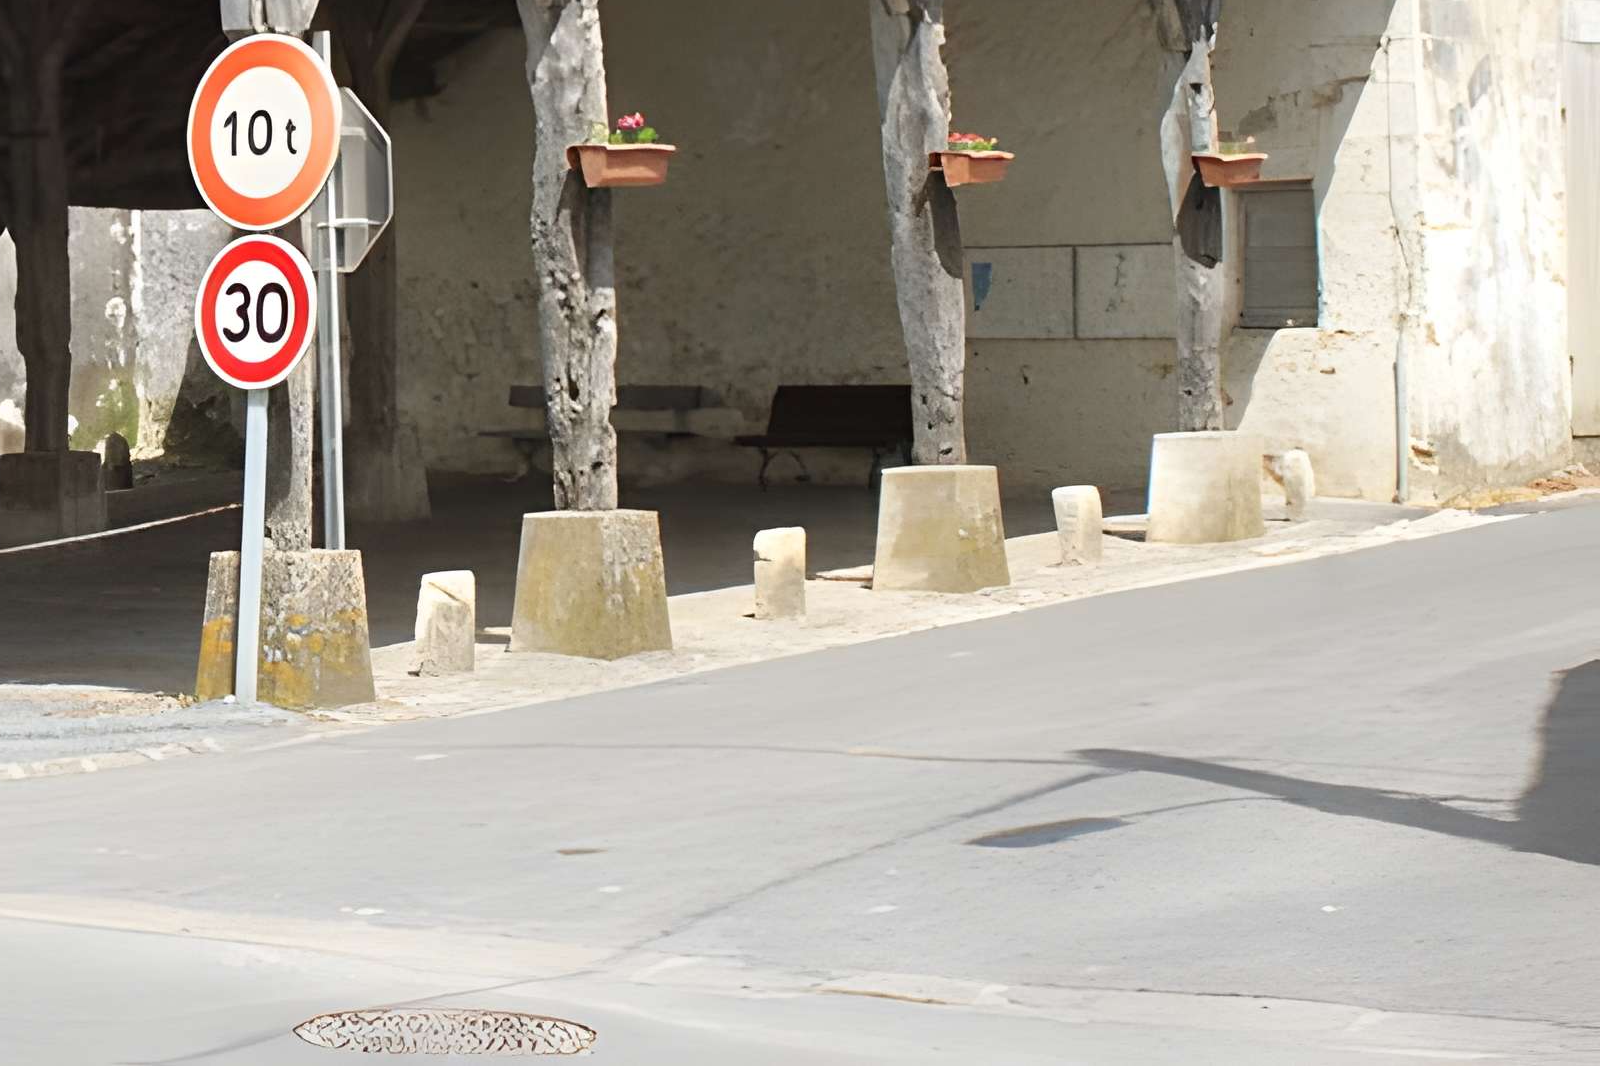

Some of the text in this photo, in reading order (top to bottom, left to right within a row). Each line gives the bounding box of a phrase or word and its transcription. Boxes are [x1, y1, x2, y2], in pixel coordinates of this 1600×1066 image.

[223, 109, 298, 156] 10 t
[222, 282, 289, 343] 30
